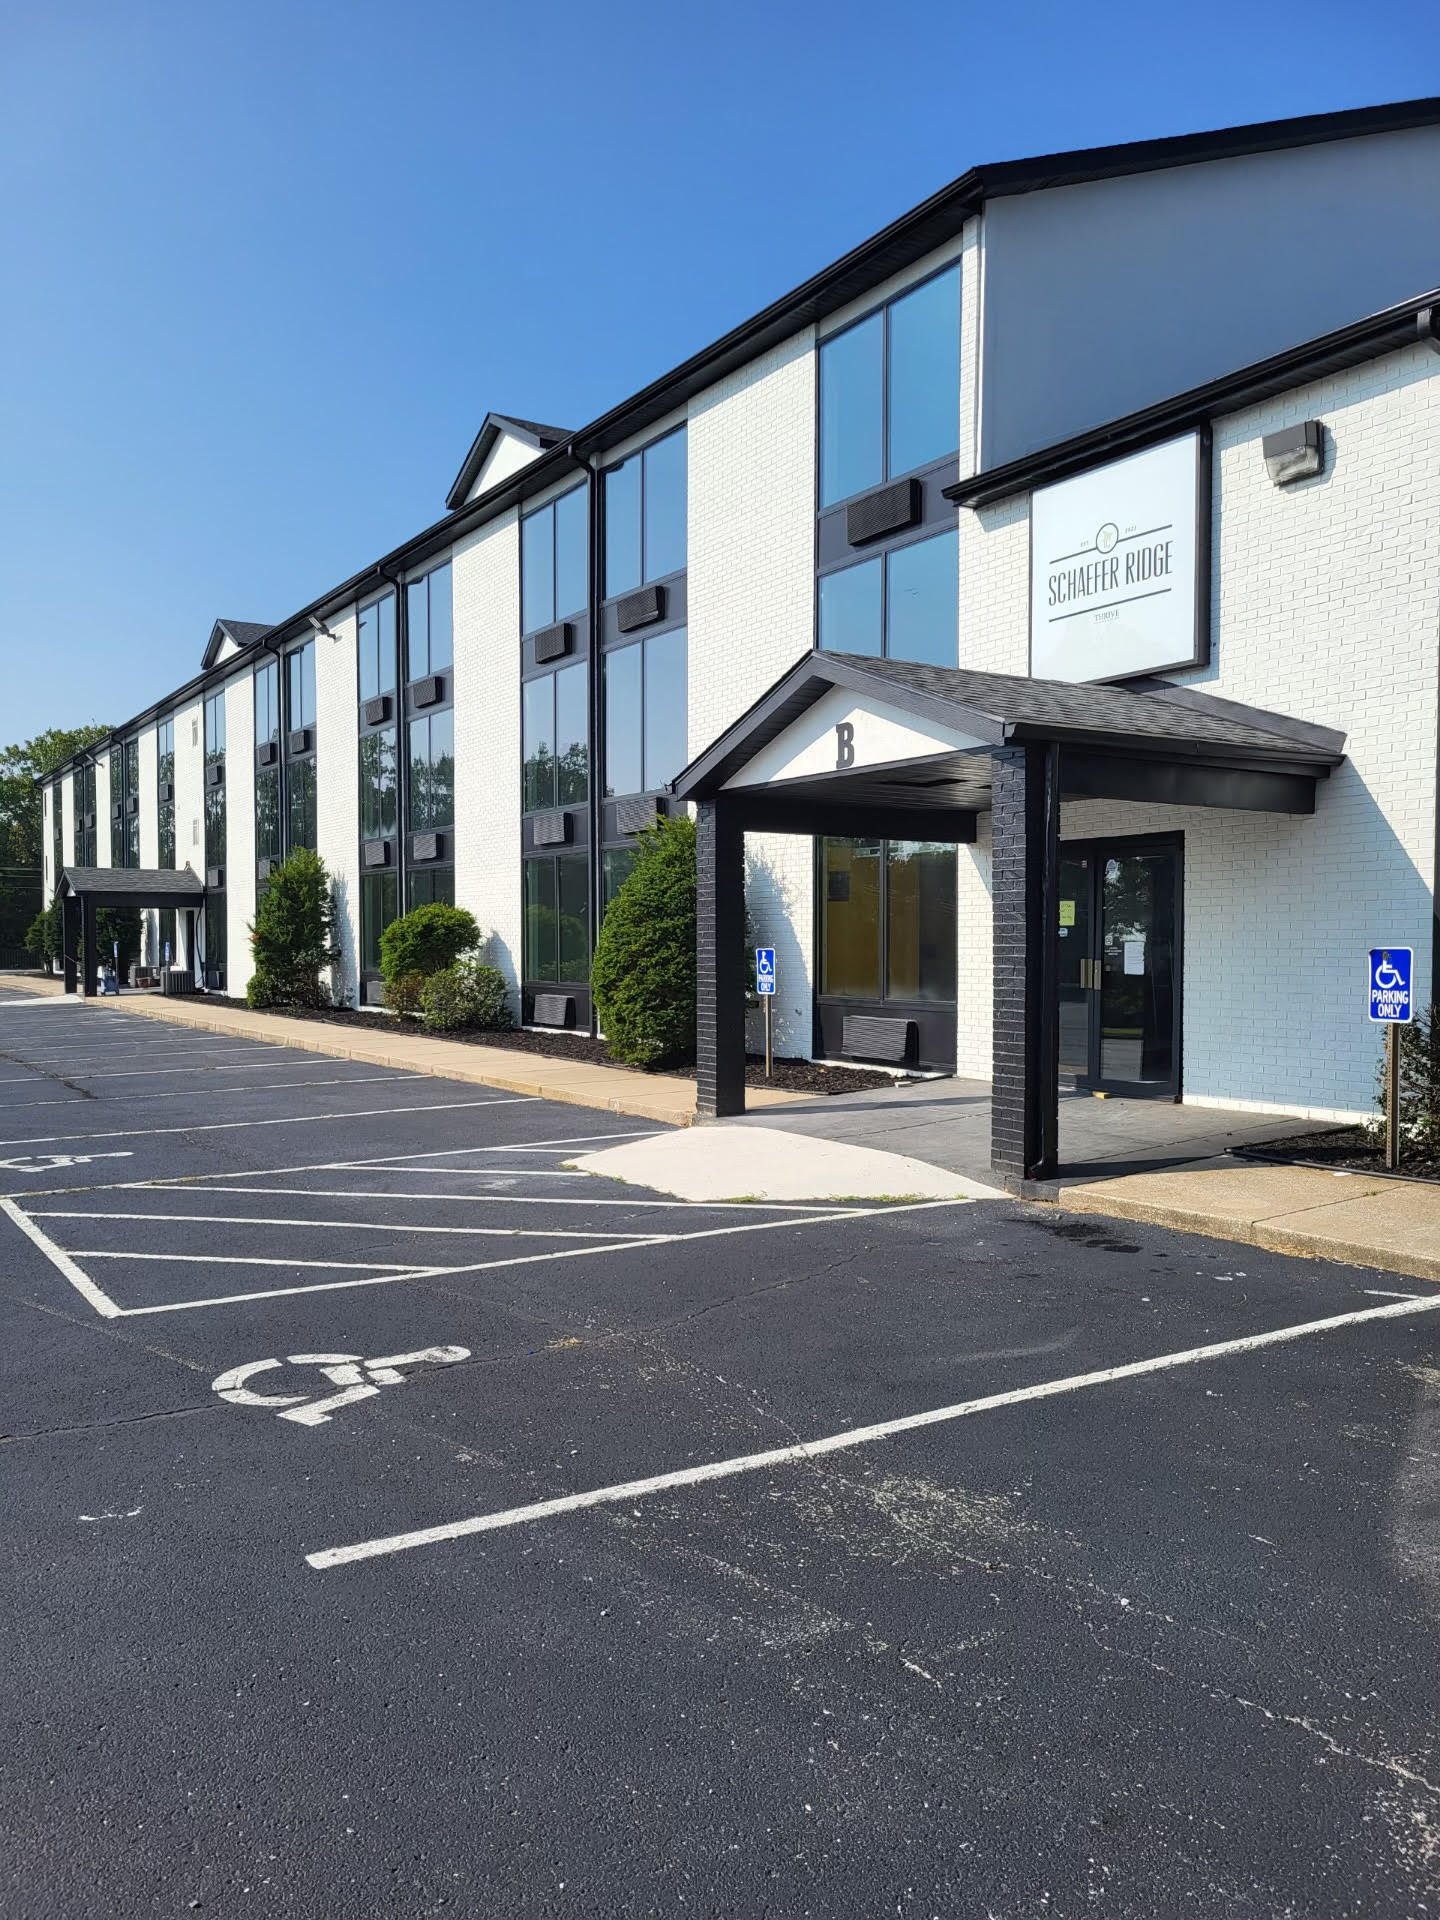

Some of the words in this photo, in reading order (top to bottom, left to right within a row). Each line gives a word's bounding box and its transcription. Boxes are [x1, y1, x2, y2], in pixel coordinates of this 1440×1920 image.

[1048, 557, 1119, 606] SCHAEFER
[1125, 540, 1173, 585] RIDGE
[836, 722, 854, 769] B
[1371, 989, 1409, 1004] PARKING
[1377, 1003, 1402, 1018] ONLY
